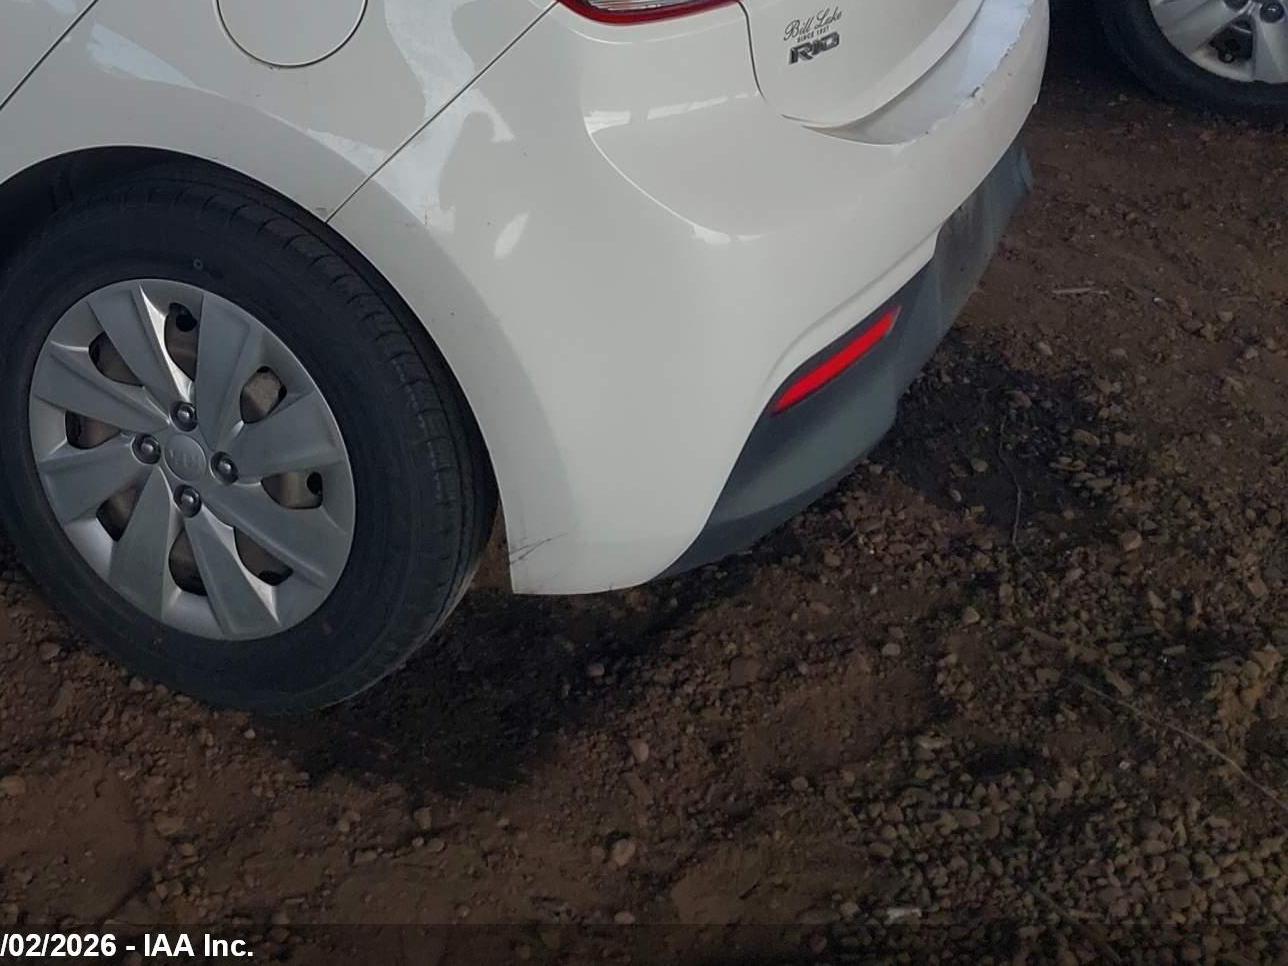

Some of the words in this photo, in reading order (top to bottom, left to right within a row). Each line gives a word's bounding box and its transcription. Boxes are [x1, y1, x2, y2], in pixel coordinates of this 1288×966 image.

[783, 16, 815, 41] Bill
[797, 31, 815, 43] SINCE
[789, 31, 840, 65] RIO
